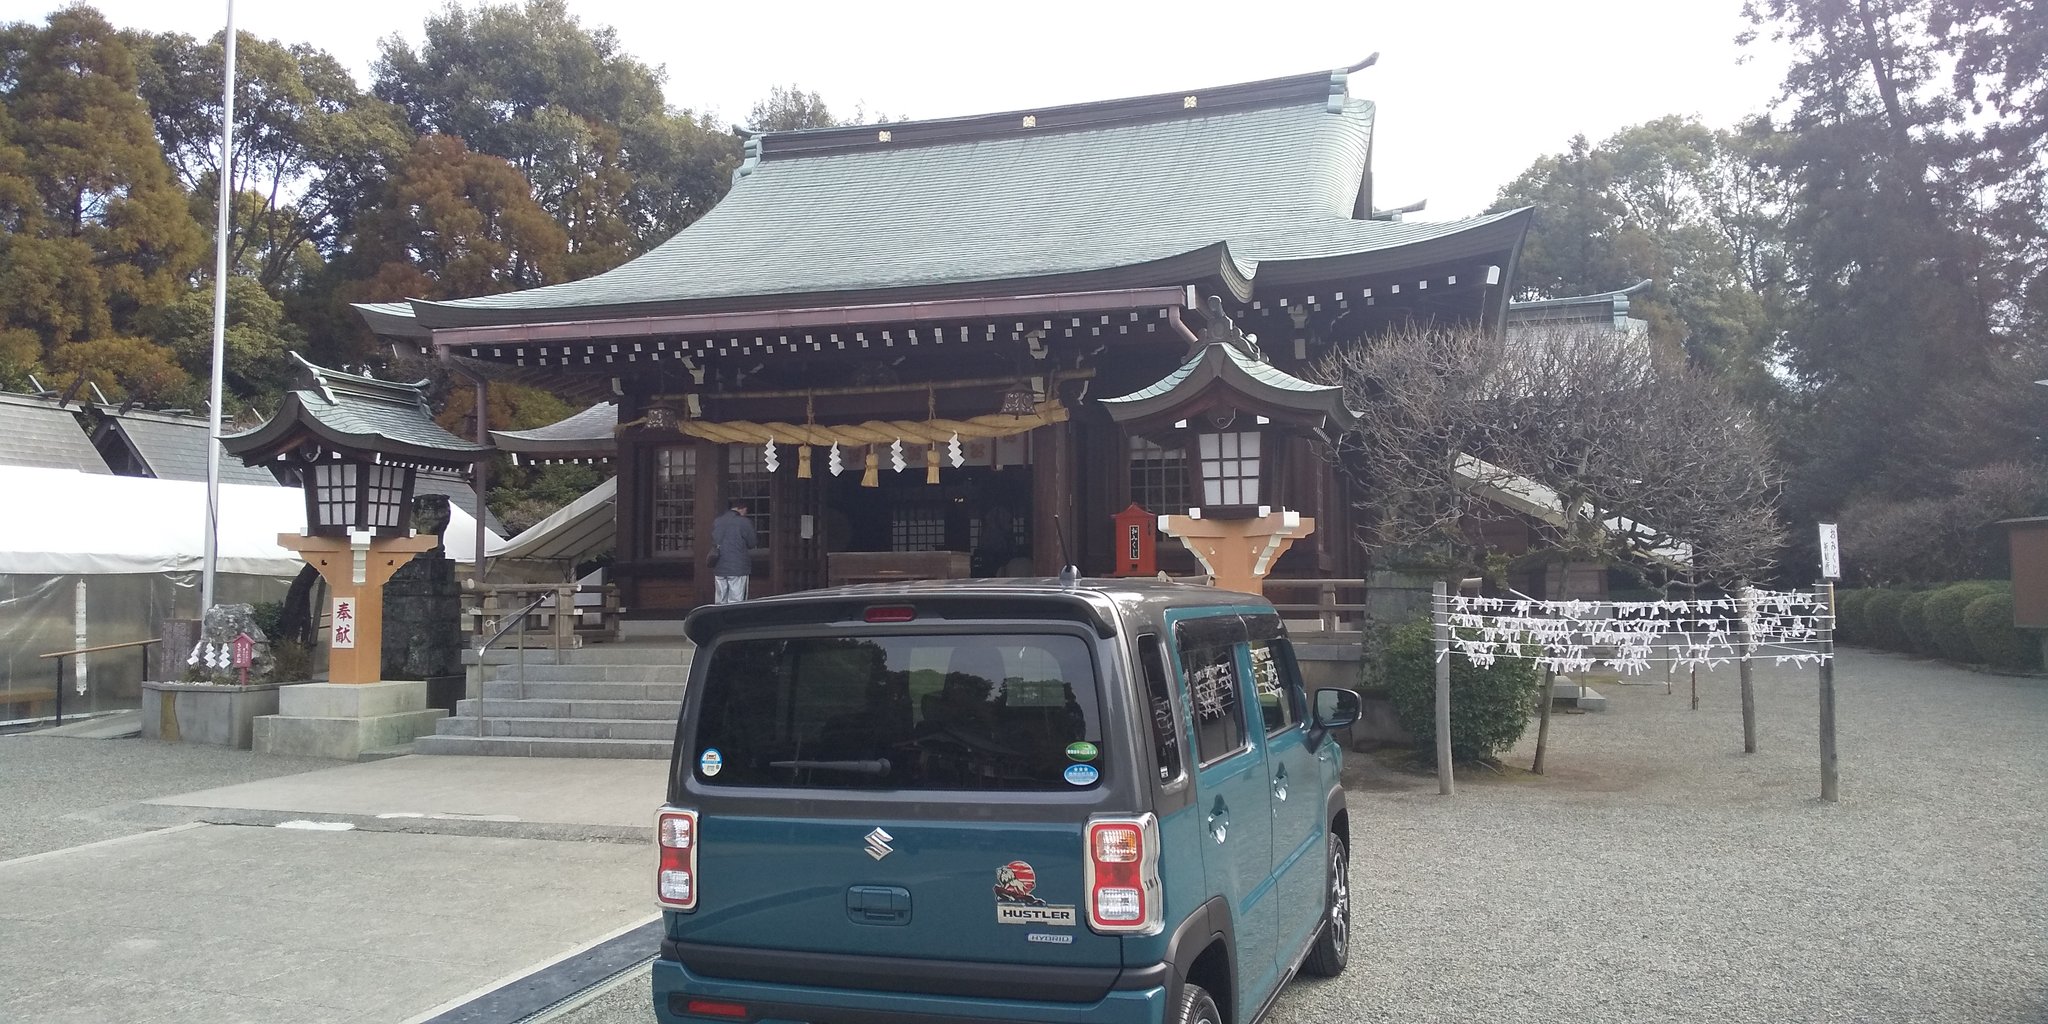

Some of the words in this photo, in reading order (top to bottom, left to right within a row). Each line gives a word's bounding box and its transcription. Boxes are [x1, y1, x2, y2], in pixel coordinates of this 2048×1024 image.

[335, 601, 353, 644] 奉献
[1003, 909, 1070, 920] HUSTLER
[1031, 934, 1069, 942] HYBRID
